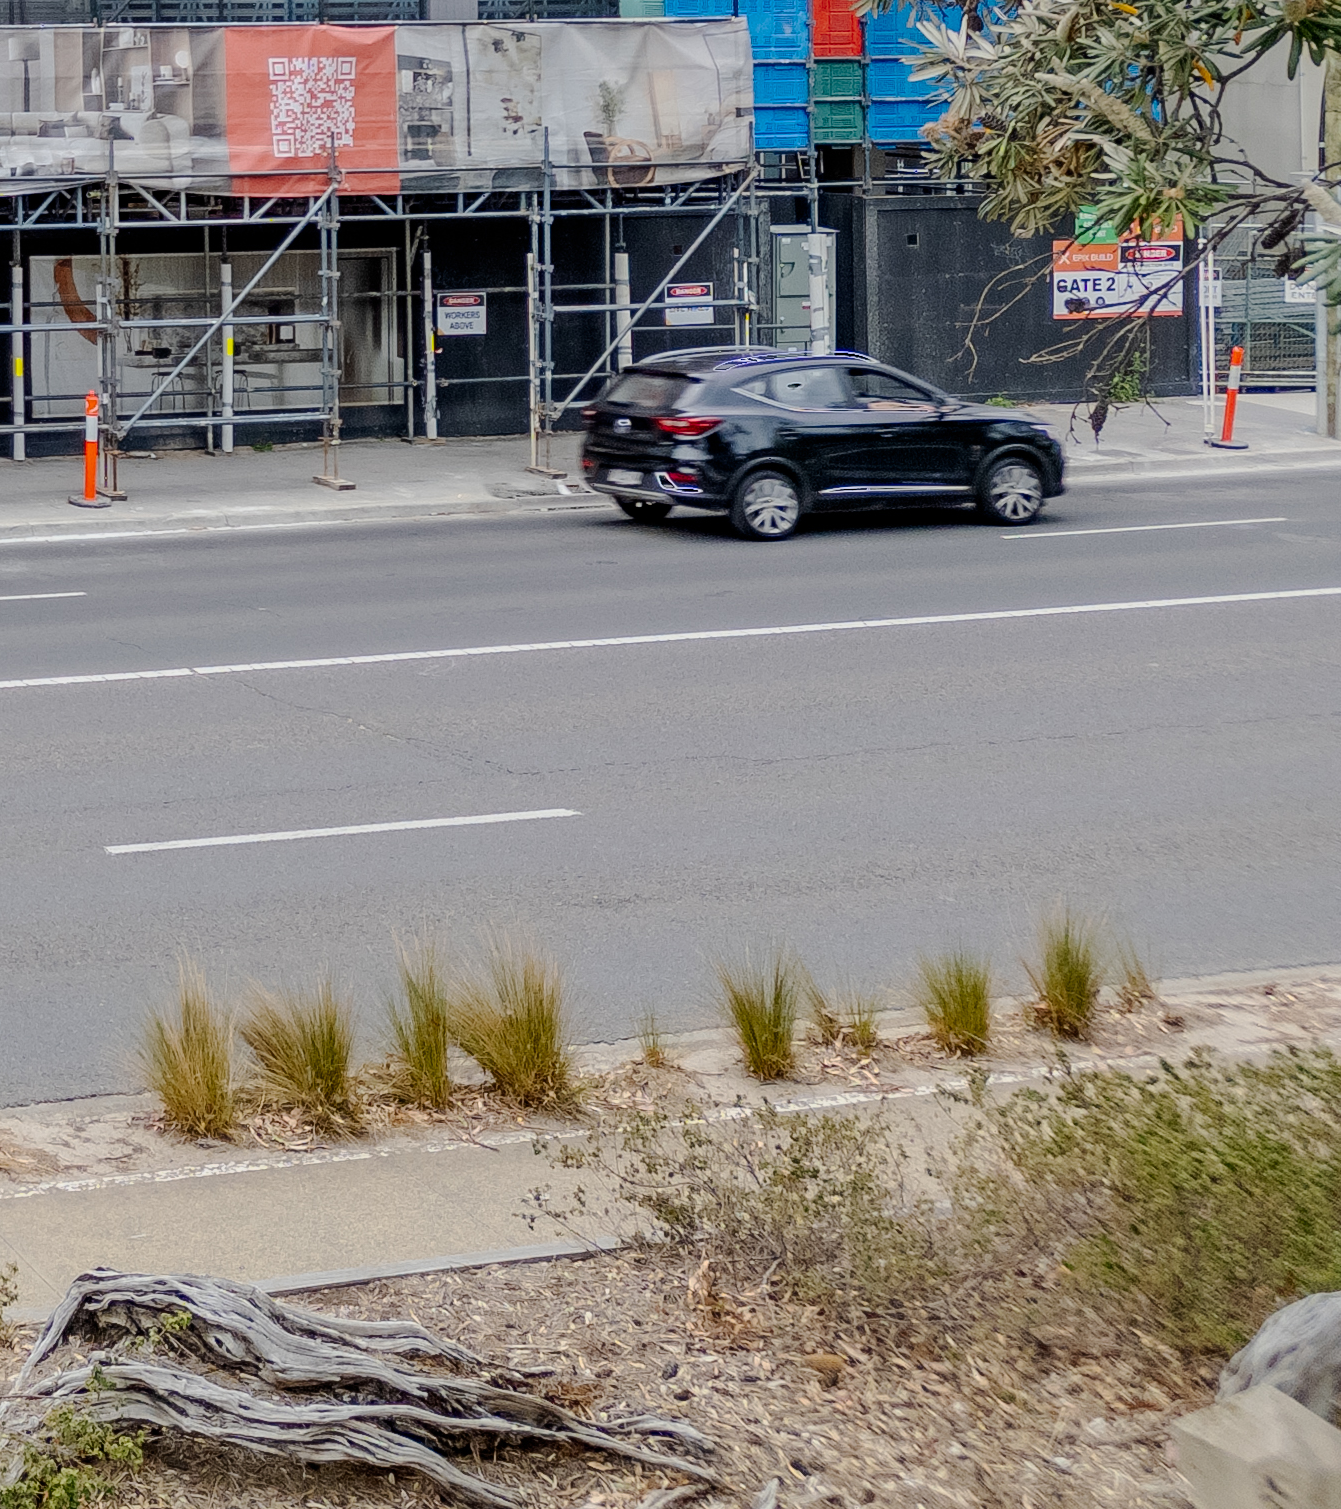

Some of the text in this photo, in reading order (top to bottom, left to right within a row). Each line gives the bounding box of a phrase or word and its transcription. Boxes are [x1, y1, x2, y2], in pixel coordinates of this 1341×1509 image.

[1056, 277, 1116, 293] GATE 2
[444, 311, 481, 319] WORKERS
[450, 322, 475, 330] ABOVE
